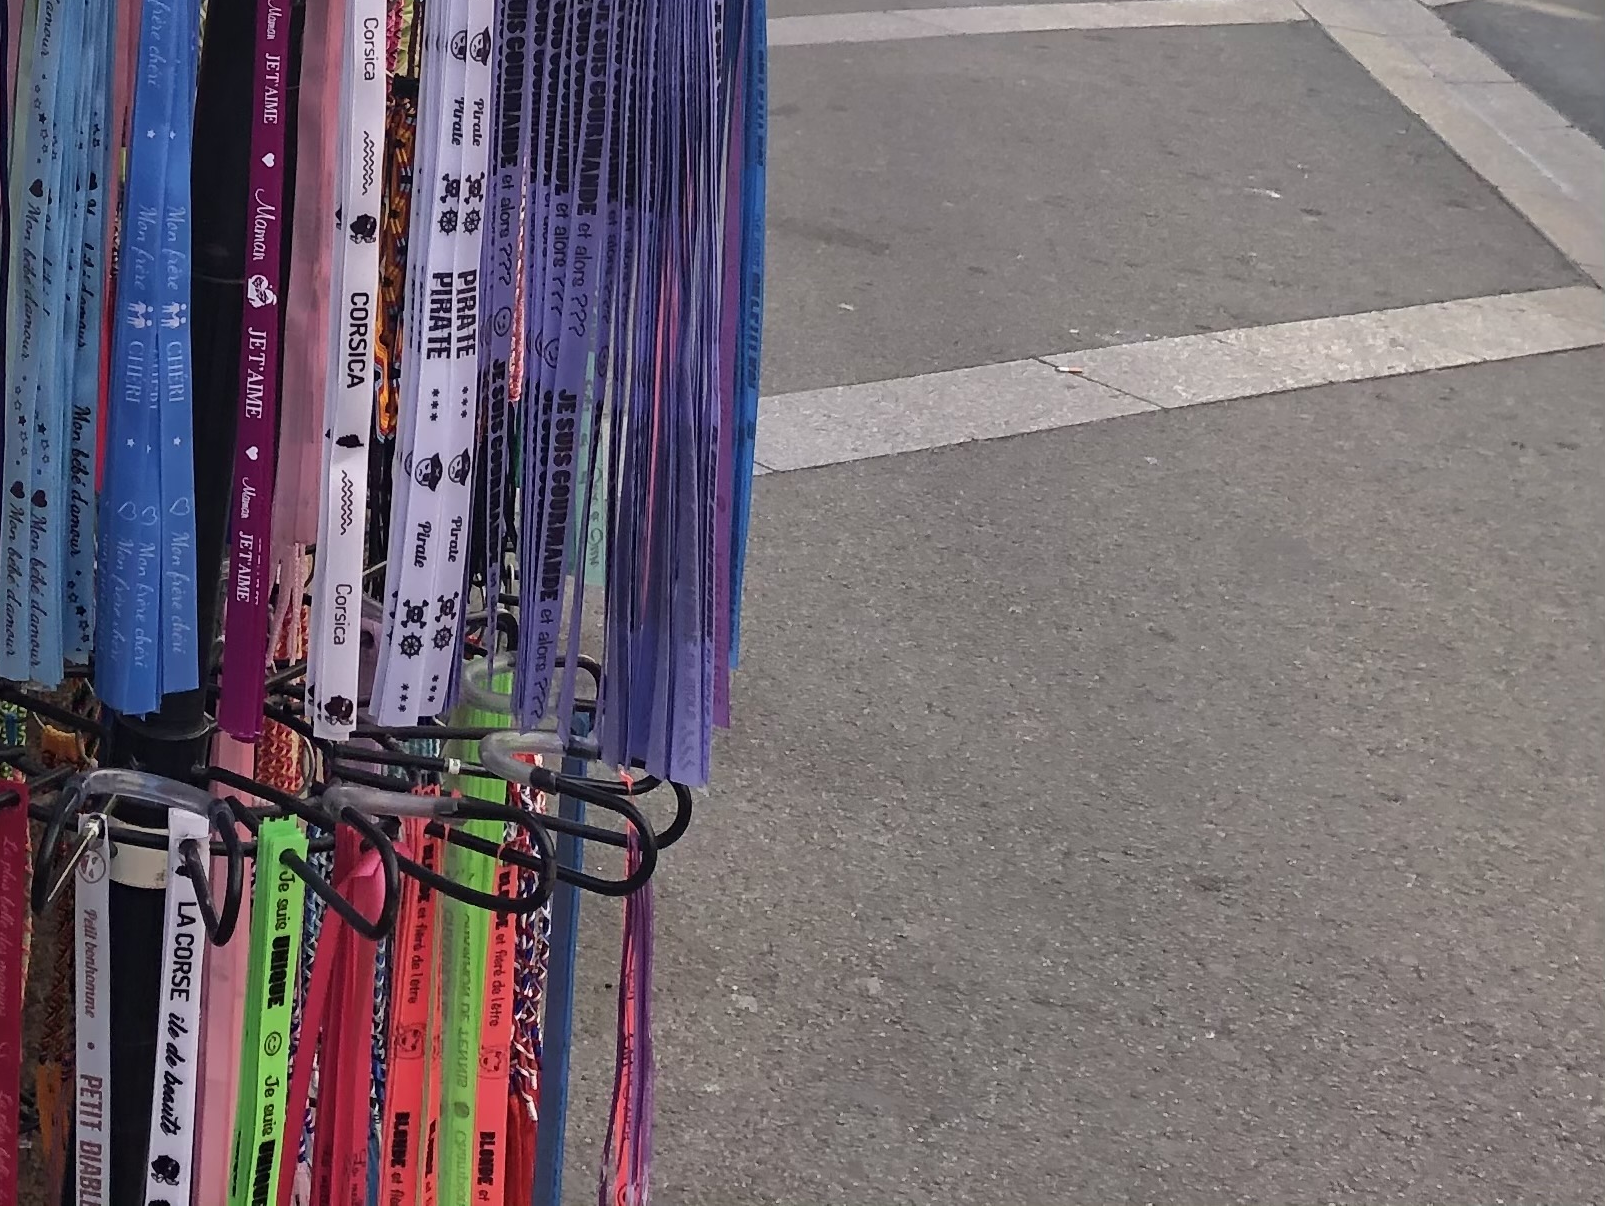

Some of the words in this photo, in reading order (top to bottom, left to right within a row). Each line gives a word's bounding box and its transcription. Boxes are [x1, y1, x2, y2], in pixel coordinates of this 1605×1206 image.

[363, 17, 378, 82] Corsica
[25, 199, 44, 240] Mon
[251, 187, 273, 262] Maman
[346, 292, 370, 390] CORSICA
[427, 271, 454, 360] PIRATE
[454, 269, 479, 359] PIRATE
[165, 340, 185, 403] CHÉRI
[551, 419, 575, 471] SUIS
[7, 503, 25, 544] Mon
[29, 514, 47, 552] Mon
[413, 520, 433, 569] Pirate
[541, 471, 573, 602] GOURMANDE
[332, 583, 354, 646] Corsica
[278, 870, 295, 893] Je
[176, 901, 198, 928] LA
[274, 897, 290, 930] suis
[82, 933, 98, 1019] bonhomme
[169, 932, 194, 1003] CORSE
[267, 935, 291, 1010] UNIQUE
[165, 1039, 186, 1070] de
[80, 1074, 104, 1132] PETIT
[264, 1075, 280, 1098] Je
[261, 1103, 277, 1137] suis
[390, 1111, 411, 1168] BLONDE
[477, 1130, 496, 1187] BLONDE
